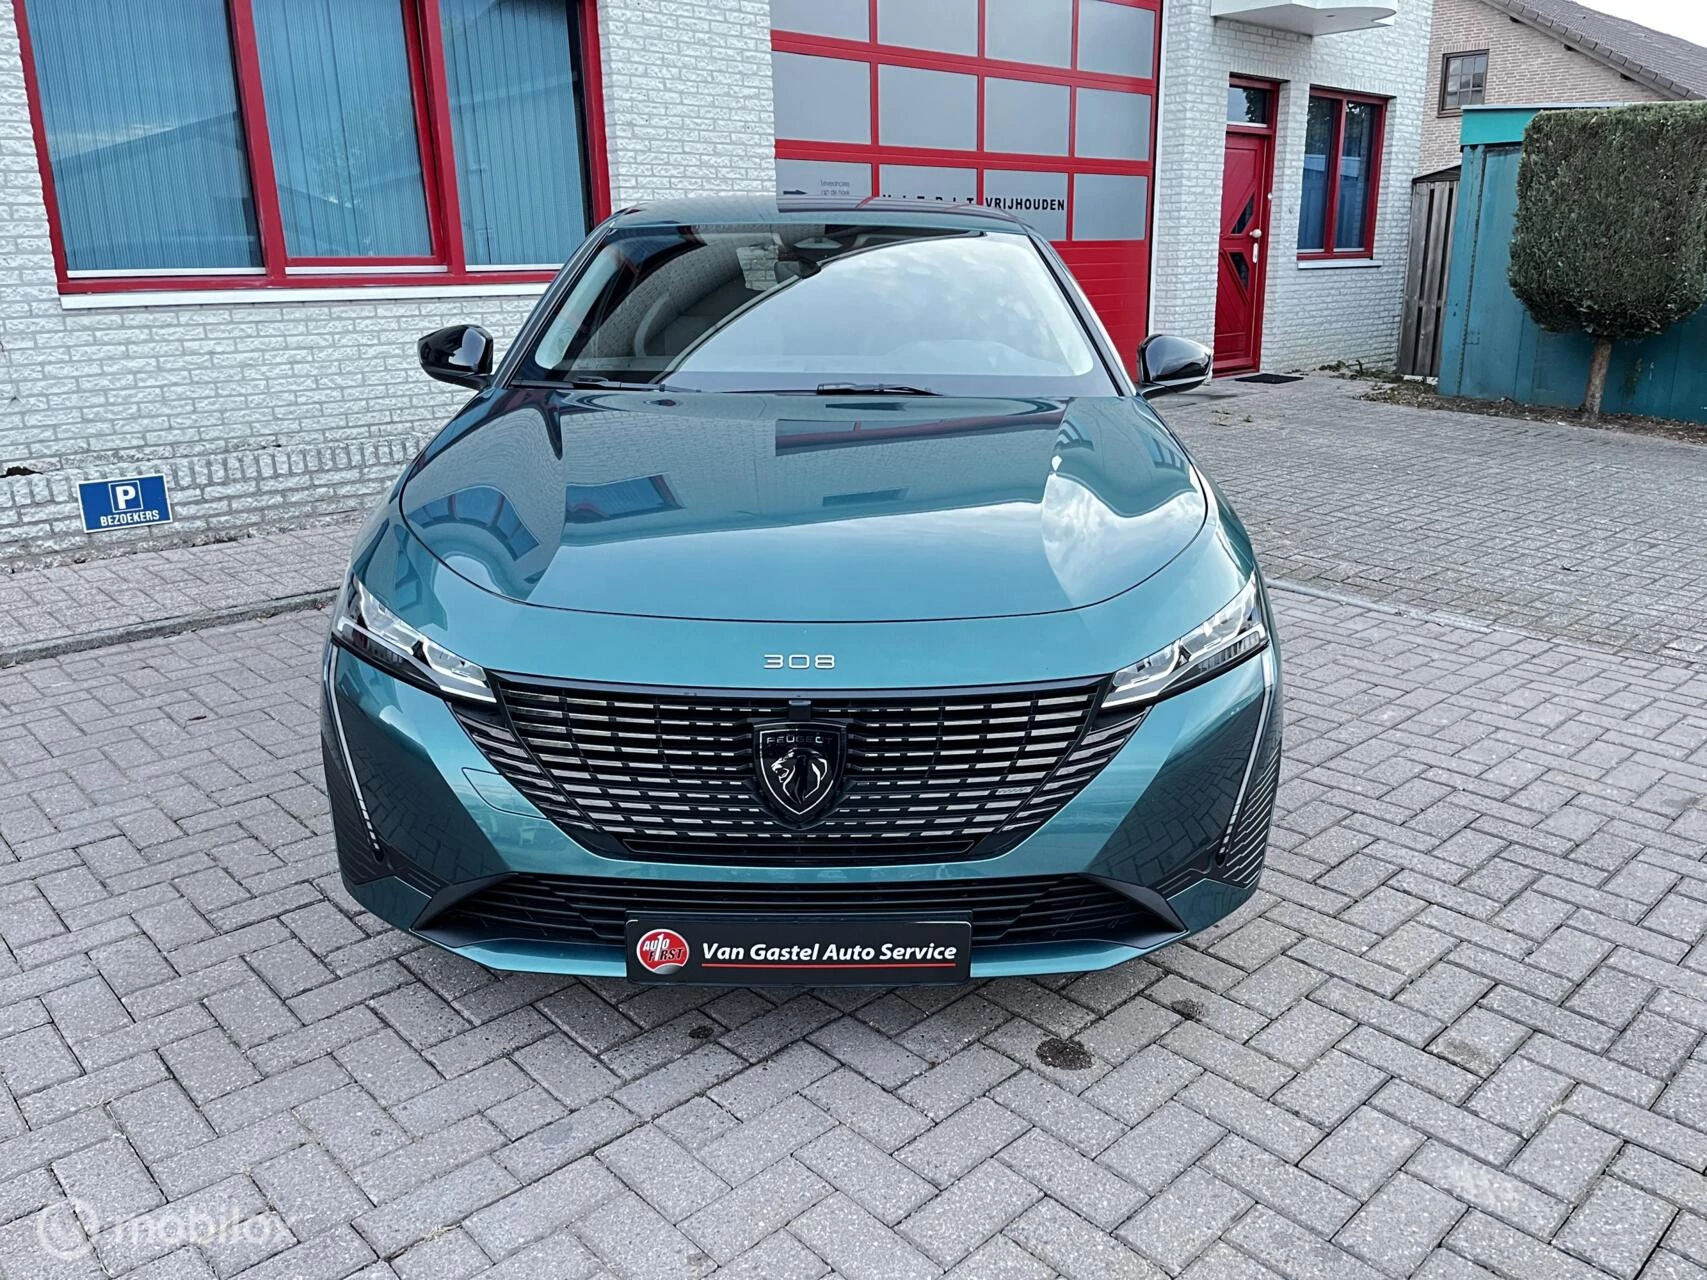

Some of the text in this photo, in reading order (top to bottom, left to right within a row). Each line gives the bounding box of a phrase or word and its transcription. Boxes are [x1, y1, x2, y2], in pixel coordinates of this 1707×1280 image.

[985, 197, 1065, 211] VRIJHOUDEN
[115, 485, 136, 510] P
[100, 509, 160, 527] BEZOEKERS
[763, 654, 835, 669] 308
[702, 942, 957, 960] Van Gastel Auto Service
